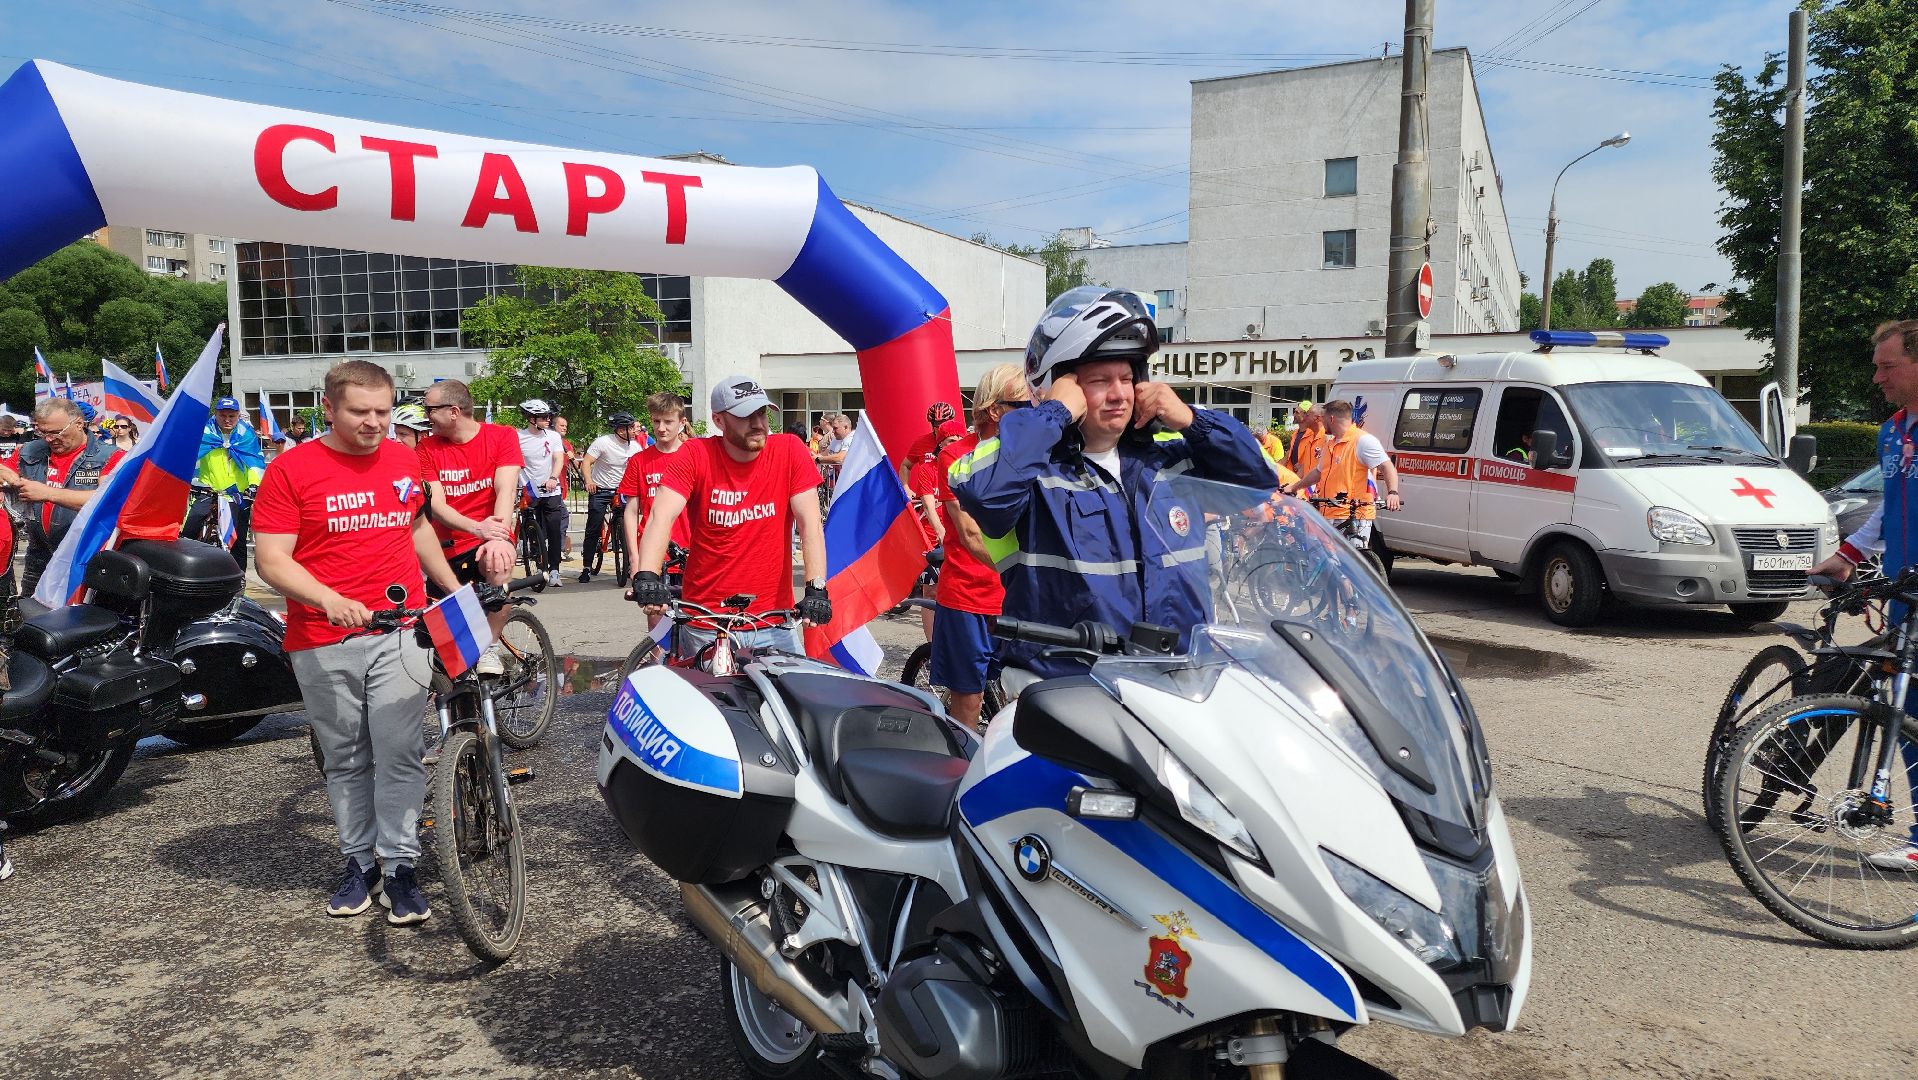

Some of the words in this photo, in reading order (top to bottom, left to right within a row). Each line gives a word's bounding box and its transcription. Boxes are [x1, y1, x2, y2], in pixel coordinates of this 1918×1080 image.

[254, 123, 703, 245] СТАРТ
[439, 468, 470, 481] СПОРТ
[1398, 457, 1456, 472] МЕДИЦИНСКАЯ
[1482, 464, 1526, 482] ПОМОЩЬ
[326, 492, 375, 513] СПОРТ
[708, 502, 776, 528] ПОДОЛЬСКА
[327, 511, 412, 533] ПОДОЛЬСКА
[612, 691, 681, 768] ПОЛИЦИЯ
